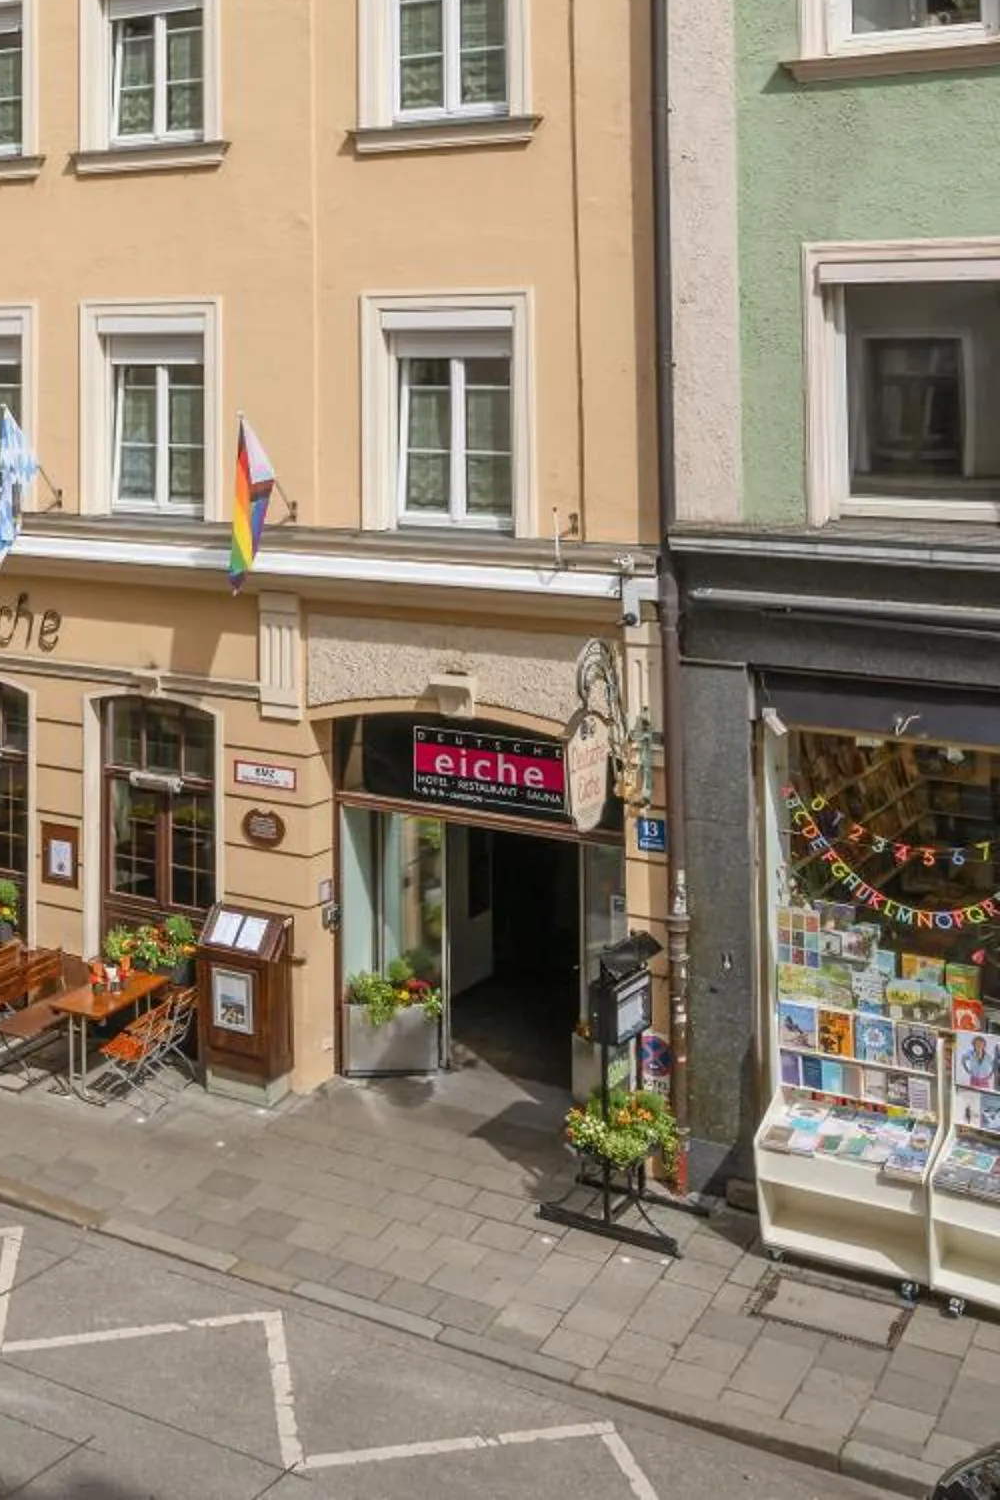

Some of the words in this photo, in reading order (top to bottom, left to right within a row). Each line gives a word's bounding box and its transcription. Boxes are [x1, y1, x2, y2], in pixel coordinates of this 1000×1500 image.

[417, 731, 562, 758] DEUTSCHE
[435, 748, 545, 789] eiche
[417, 774, 449, 787] HOTEL
[457, 780, 517, 797] RESTAURANT
[526, 790, 561, 804] SAUNA
[641, 820, 658, 837] 13
